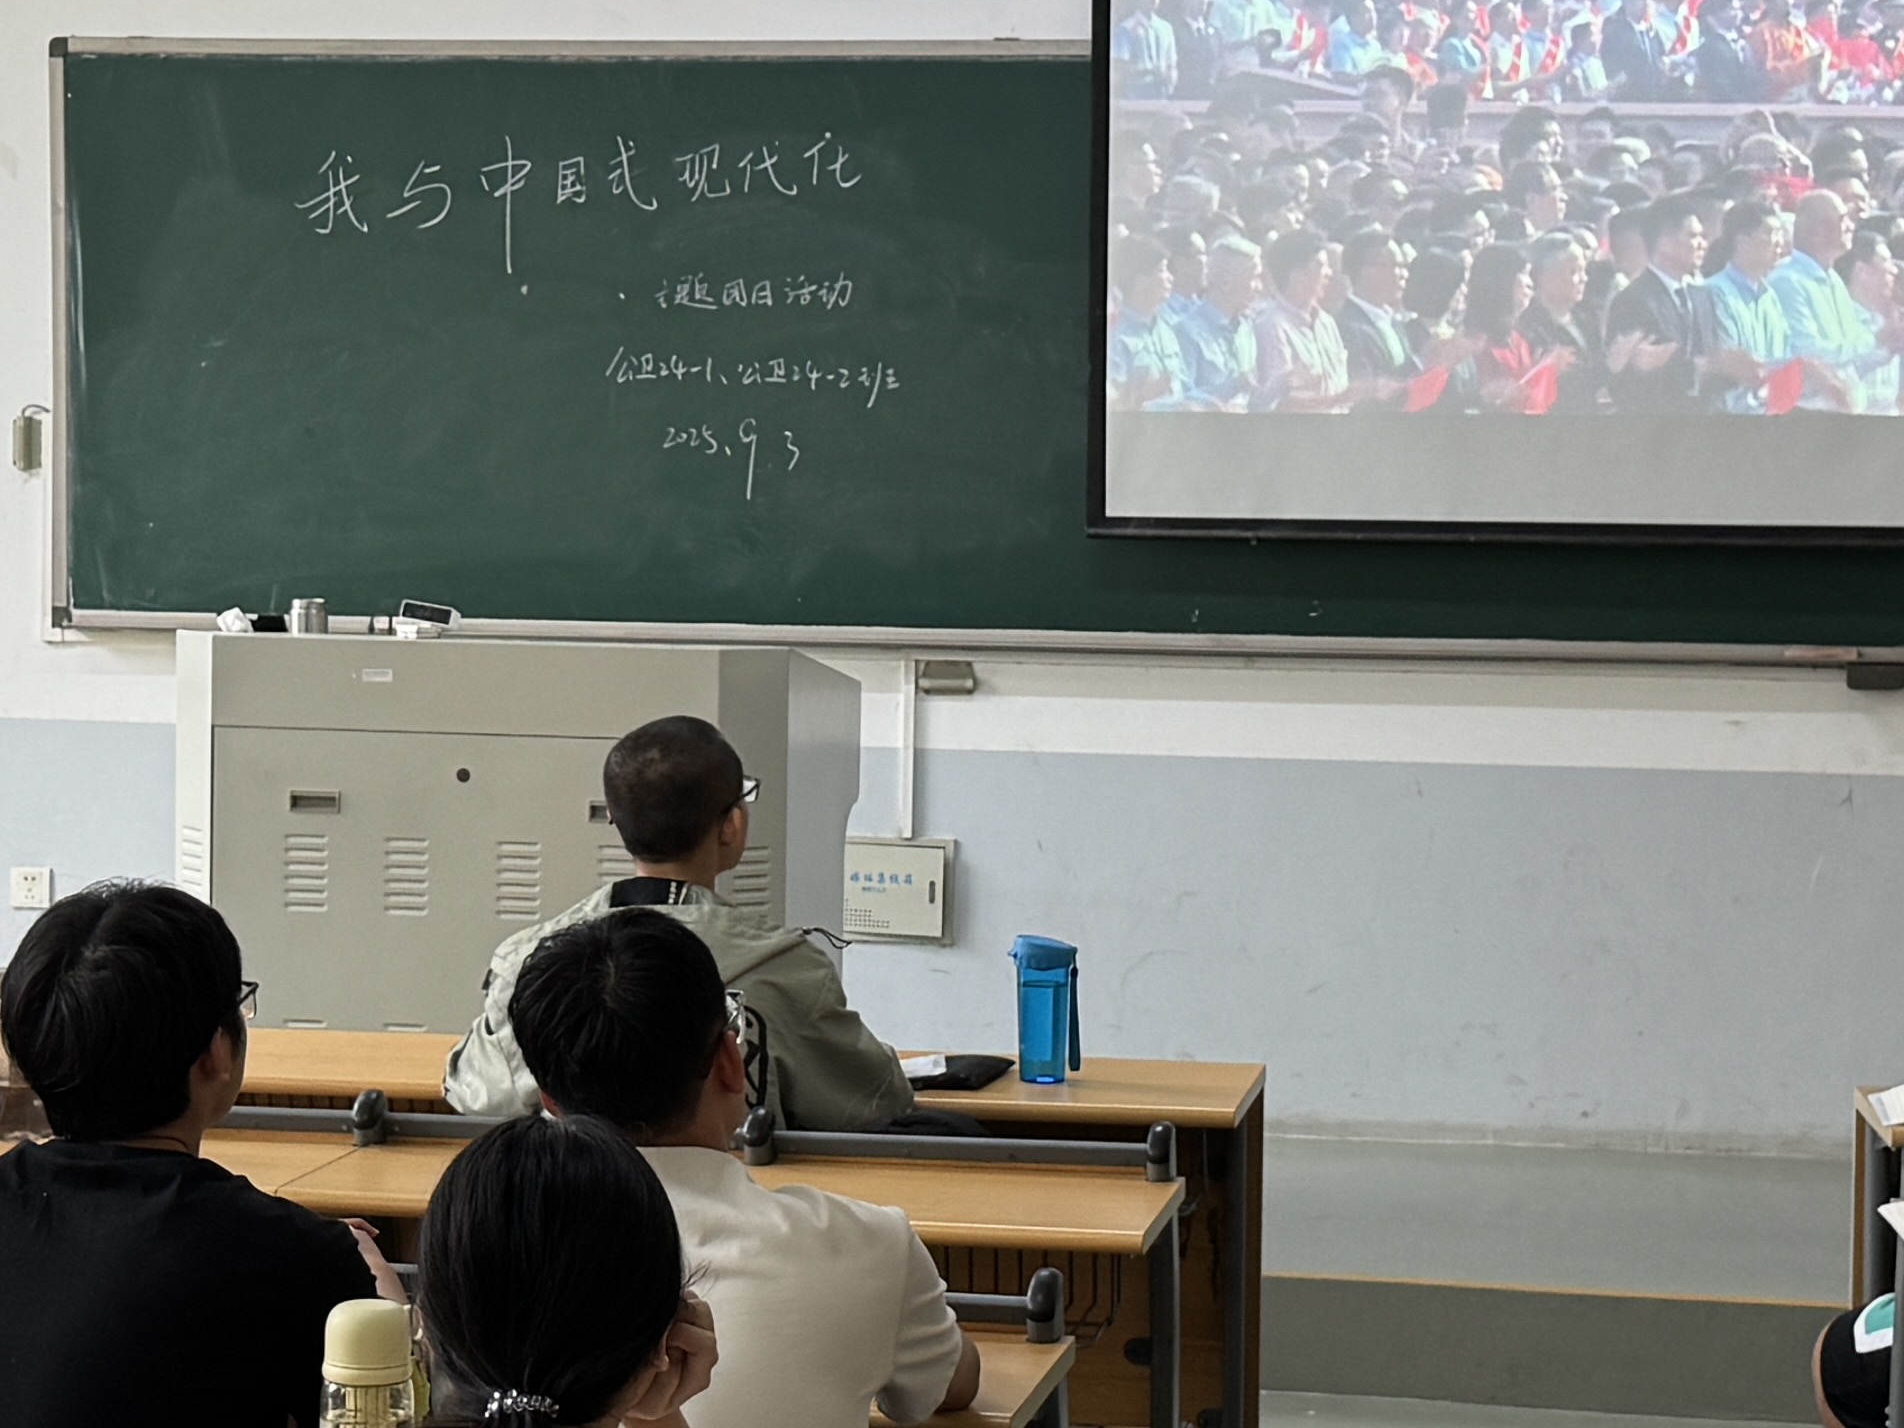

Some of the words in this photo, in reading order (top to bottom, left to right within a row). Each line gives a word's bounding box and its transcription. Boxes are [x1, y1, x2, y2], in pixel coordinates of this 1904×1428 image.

[294, 132, 864, 274] 我与中国式现代化
[655, 271, 853, 309] 主题团日活动
